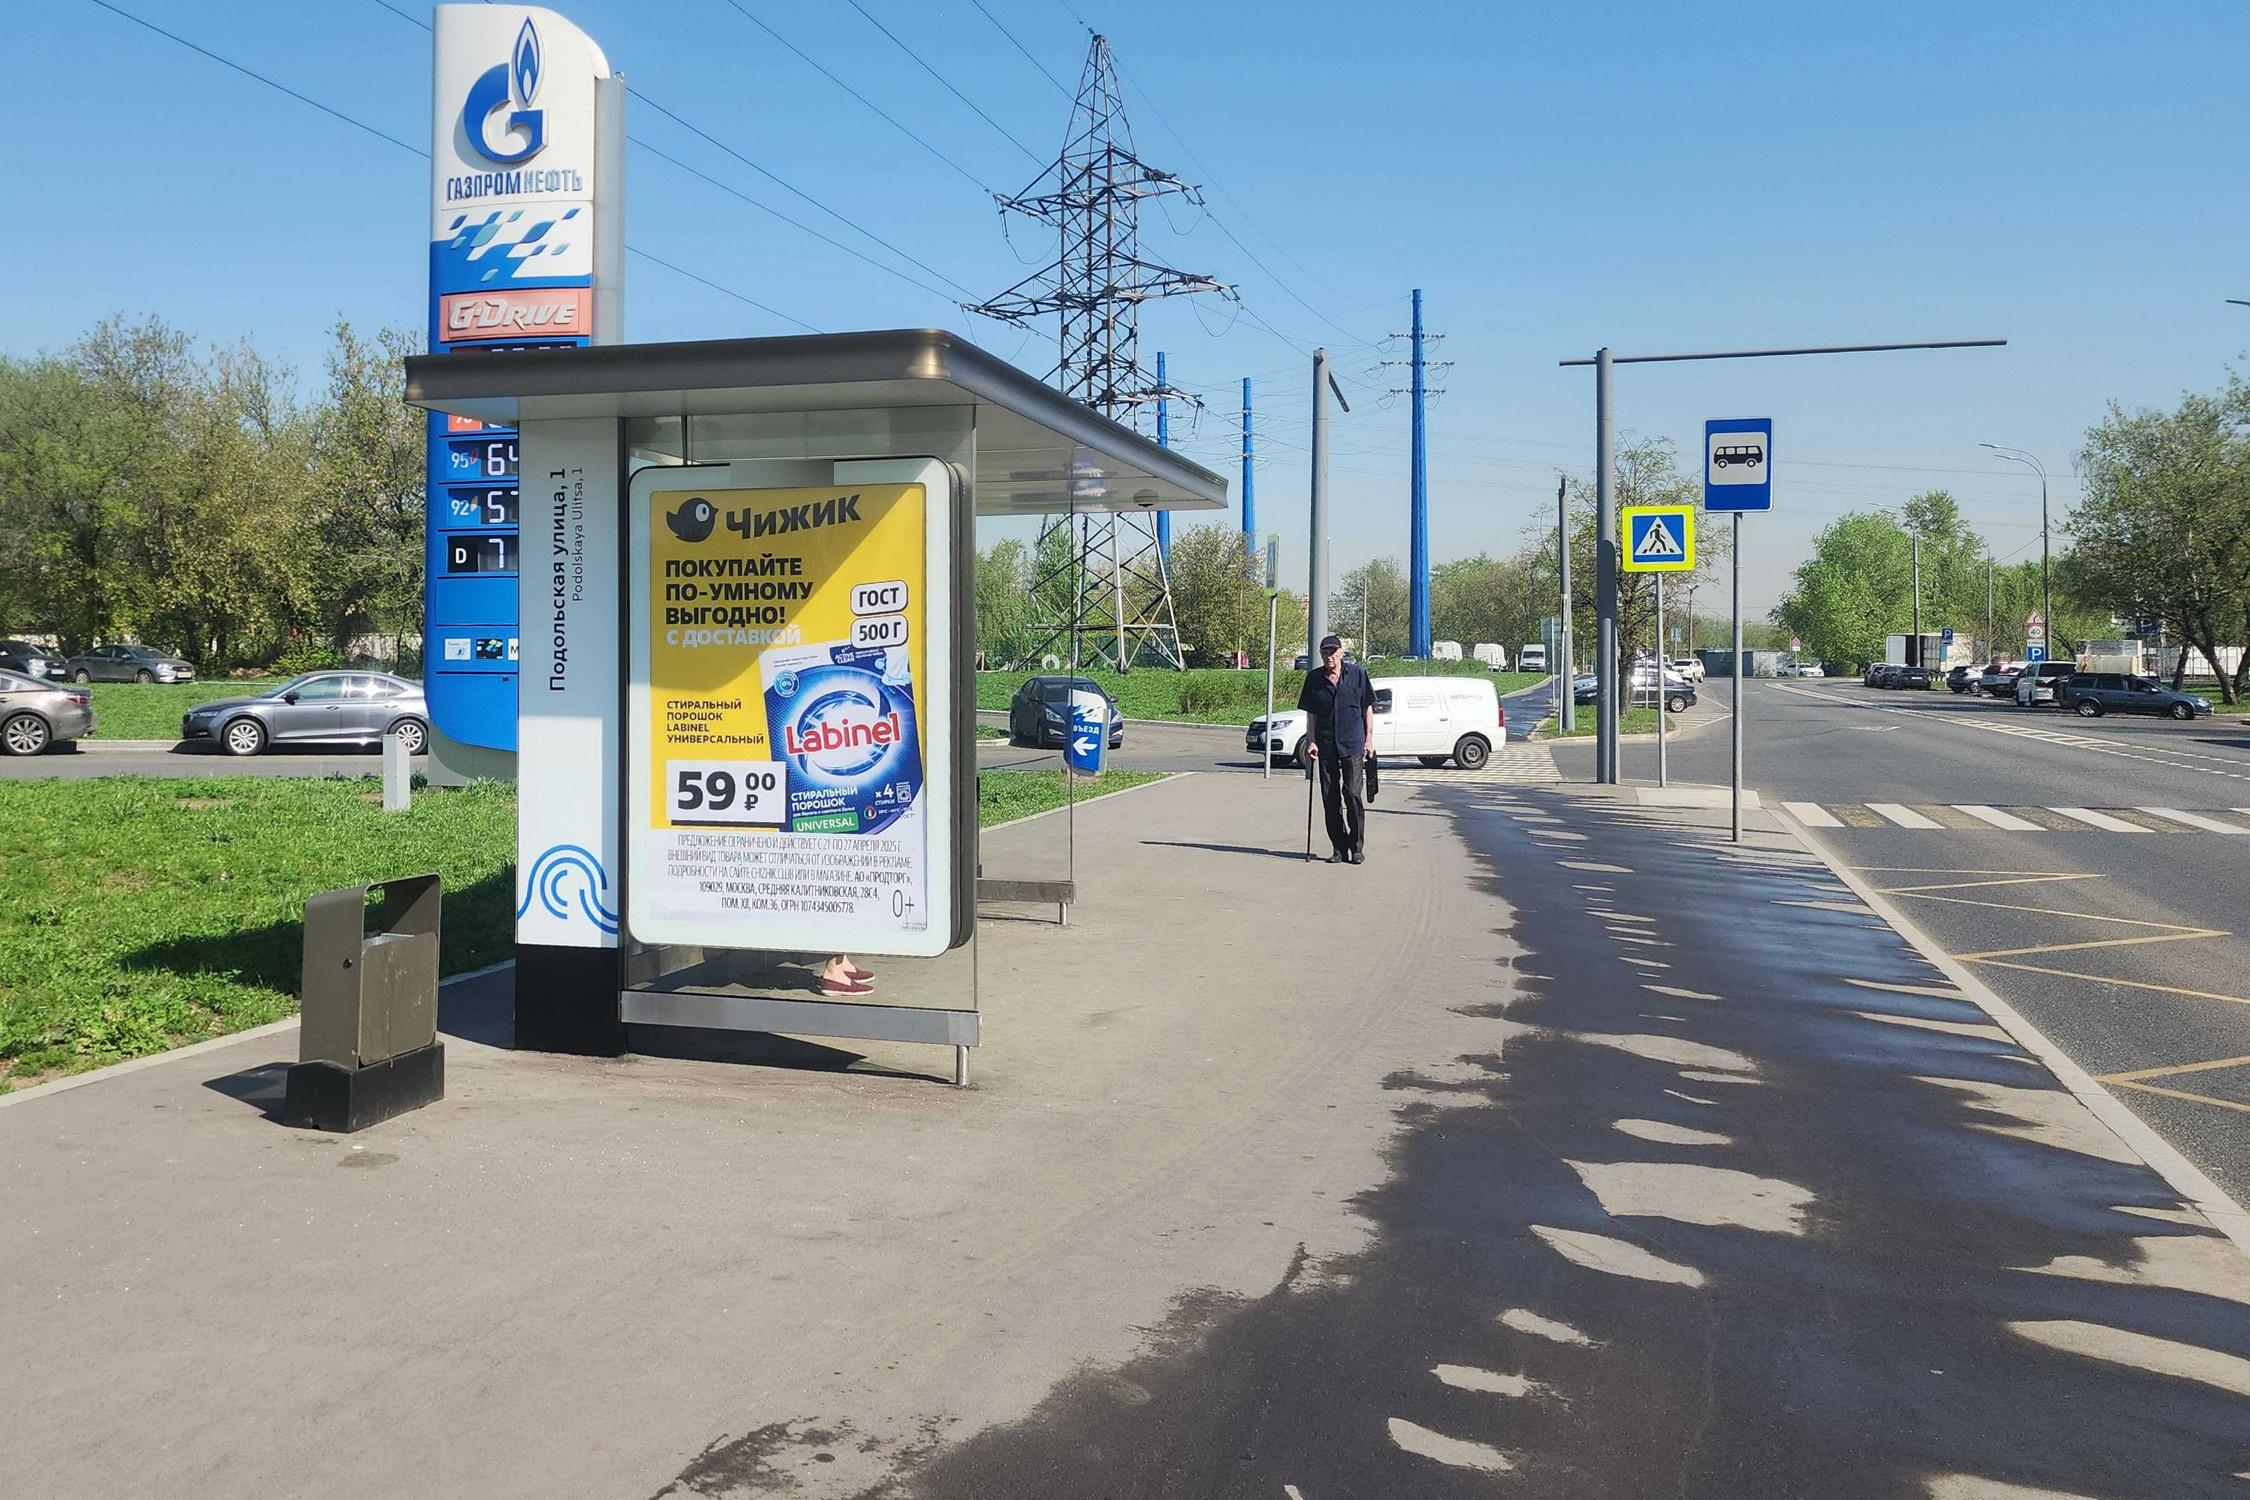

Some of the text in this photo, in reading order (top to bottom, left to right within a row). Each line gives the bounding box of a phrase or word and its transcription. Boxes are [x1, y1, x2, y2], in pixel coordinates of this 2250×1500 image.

[447, 168, 583, 202] ГАЗПРОМНЕФТЬ
[451, 452, 469, 468] 95
[451, 499, 469, 516] 92
[571, 478, 585, 520] Ulitsa,
[455, 547, 467, 564] D
[571, 524, 586, 602] Podolskaya
[665, 553, 803, 578] ПОКУПАЙТЕ
[549, 468, 569, 691] Подольская улица, 1
[665, 582, 814, 601] ПО-УМНОМУ
[859, 587, 900, 608] ГОСТ
[665, 606, 786, 628] ВЫГОДНО!
[666, 625, 801, 648] С ДОСТАВКОЙ
[859, 621, 902, 642] 500 Г
[2031, 648, 2042, 660] P
[666, 698, 742, 710] СТИРАЛЬНЫЙ
[666, 711, 723, 721] ПОРОШОК
[666, 723, 710, 732] LABINEL
[785, 712, 901, 755] Labinel
[1073, 724, 1099, 735] ВЪЕЗД
[666, 733, 764, 744] УНИВЕРСАЛЬНЫЙ
[677, 771, 736, 811] 59
[745, 772, 776, 791] 00
[791, 797, 846, 811] ПОРОШОК
[796, 817, 855, 832] UNIVERSAL
[678, 834, 727, 848] ПРЕДЛОЖЕНИЕ
[728, 835, 772, 848] ОГРАНИЧЕНО
[779, 834, 817, 851] ДЕЙСТВУЕТ
[832, 838, 843, 850] ПО
[843, 838, 852, 850] 27
[852, 839, 879, 852] АПРЕЛЯ
[880, 840, 896, 853] 2025
[668, 847, 702, 861] ВНЕШНИЙ
[702, 850, 717, 864] ВИД
[717, 850, 742, 863] ТОВАРА
[743, 851, 767, 864] МОЖЕТ
[768, 852, 811, 866] ОТЛИЧАТЬСЯ
[811, 853, 820, 866] ОТ
[821, 853, 872, 868] ИЗОБРАЖЕНИЙ
[668, 864, 718, 879] ПОДРОБНОСТИ
[718, 866, 728, 878] НА
[729, 863, 751, 879] САЙТЕ
[795, 868, 810, 881] ИЛИ
[854, 871, 865, 883] АО
[699, 881, 725, 895] 109029,
[725, 881, 758, 896] МОСКВА,
[758, 883, 789, 898] СРЕДНЯЯ
[790, 884, 860, 900] КАЛИТНИКОВСКАЯ,
[721, 897, 740, 909] ПОМ.
[780, 899, 800, 912] ОГРН
[892, 889, 915, 917] 0+
